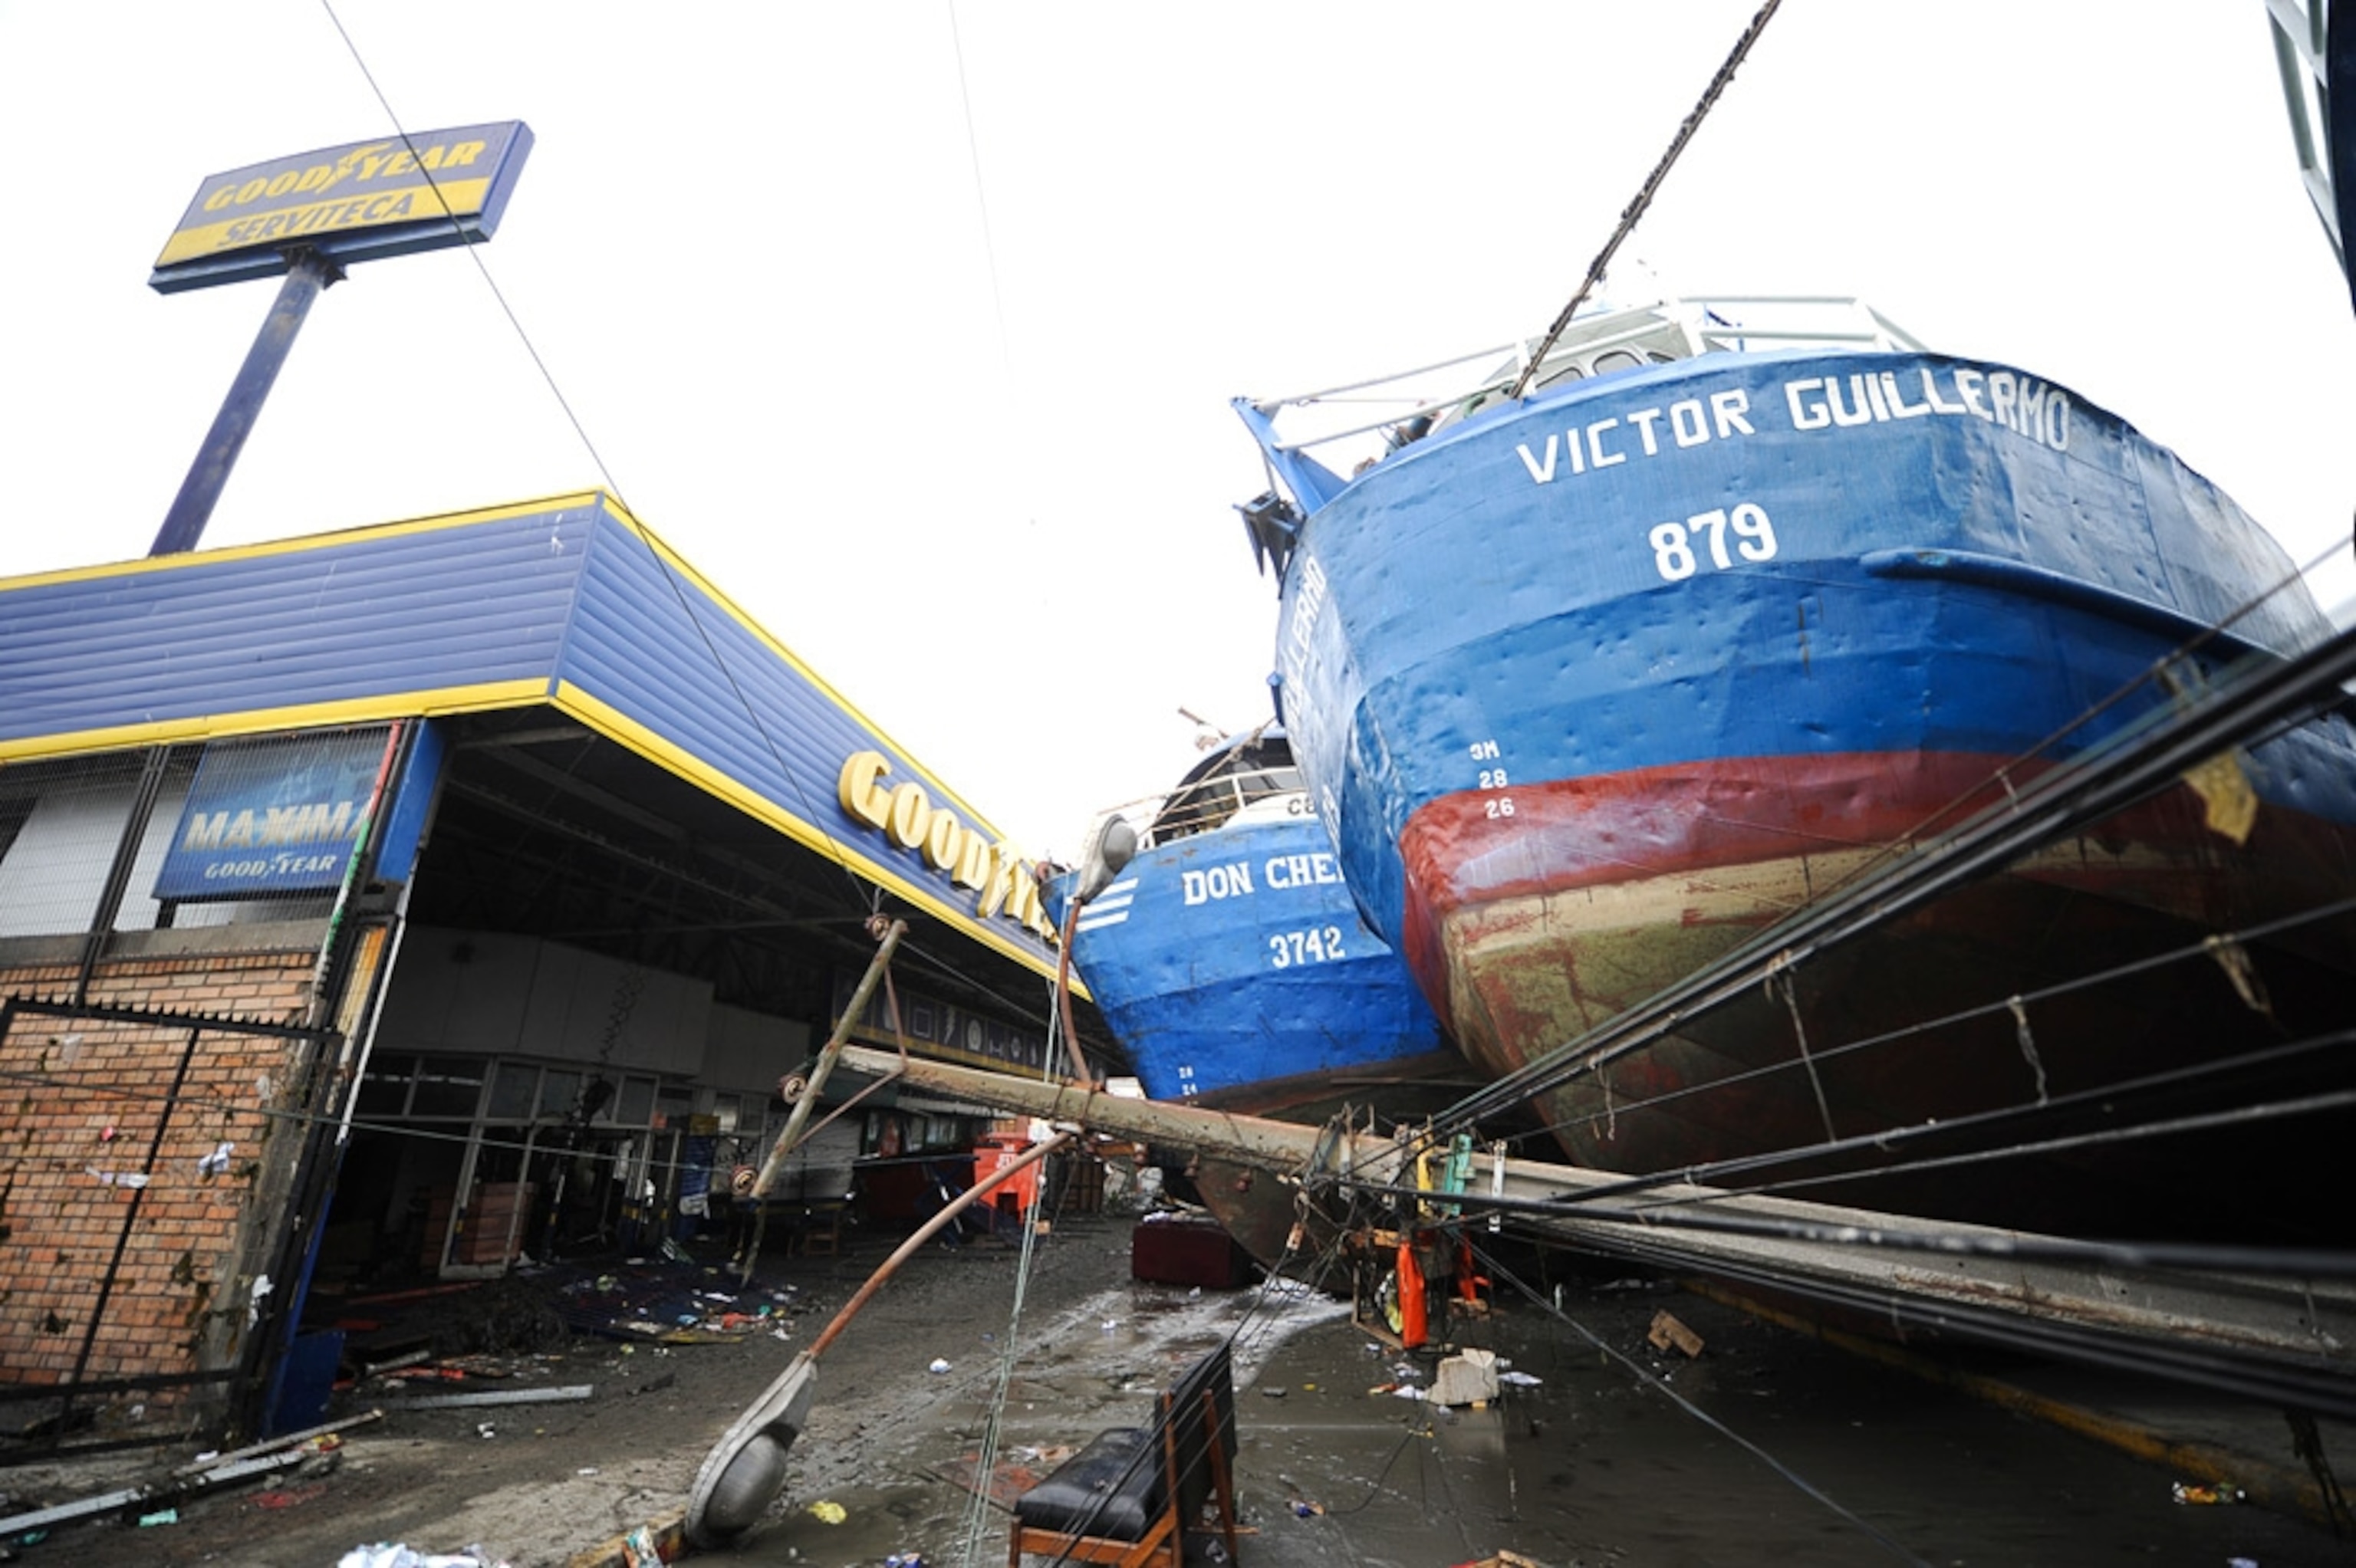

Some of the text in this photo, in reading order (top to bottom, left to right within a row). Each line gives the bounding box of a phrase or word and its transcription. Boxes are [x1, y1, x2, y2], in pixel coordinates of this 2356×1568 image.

[203, 140, 486, 212] GOODYEAR
[216, 193, 415, 247] SERVITECA
[1516, 368, 2070, 484] VICTOR GUILLERMO
[1648, 503, 1779, 582] 879
[1469, 739, 1501, 761] 3M
[1479, 768, 1508, 789] 28
[1484, 797, 1515, 820] 26
[204, 851, 337, 879] GOODYEAR
[1181, 861, 1255, 906] DON
[1269, 925, 1346, 969] 3742
